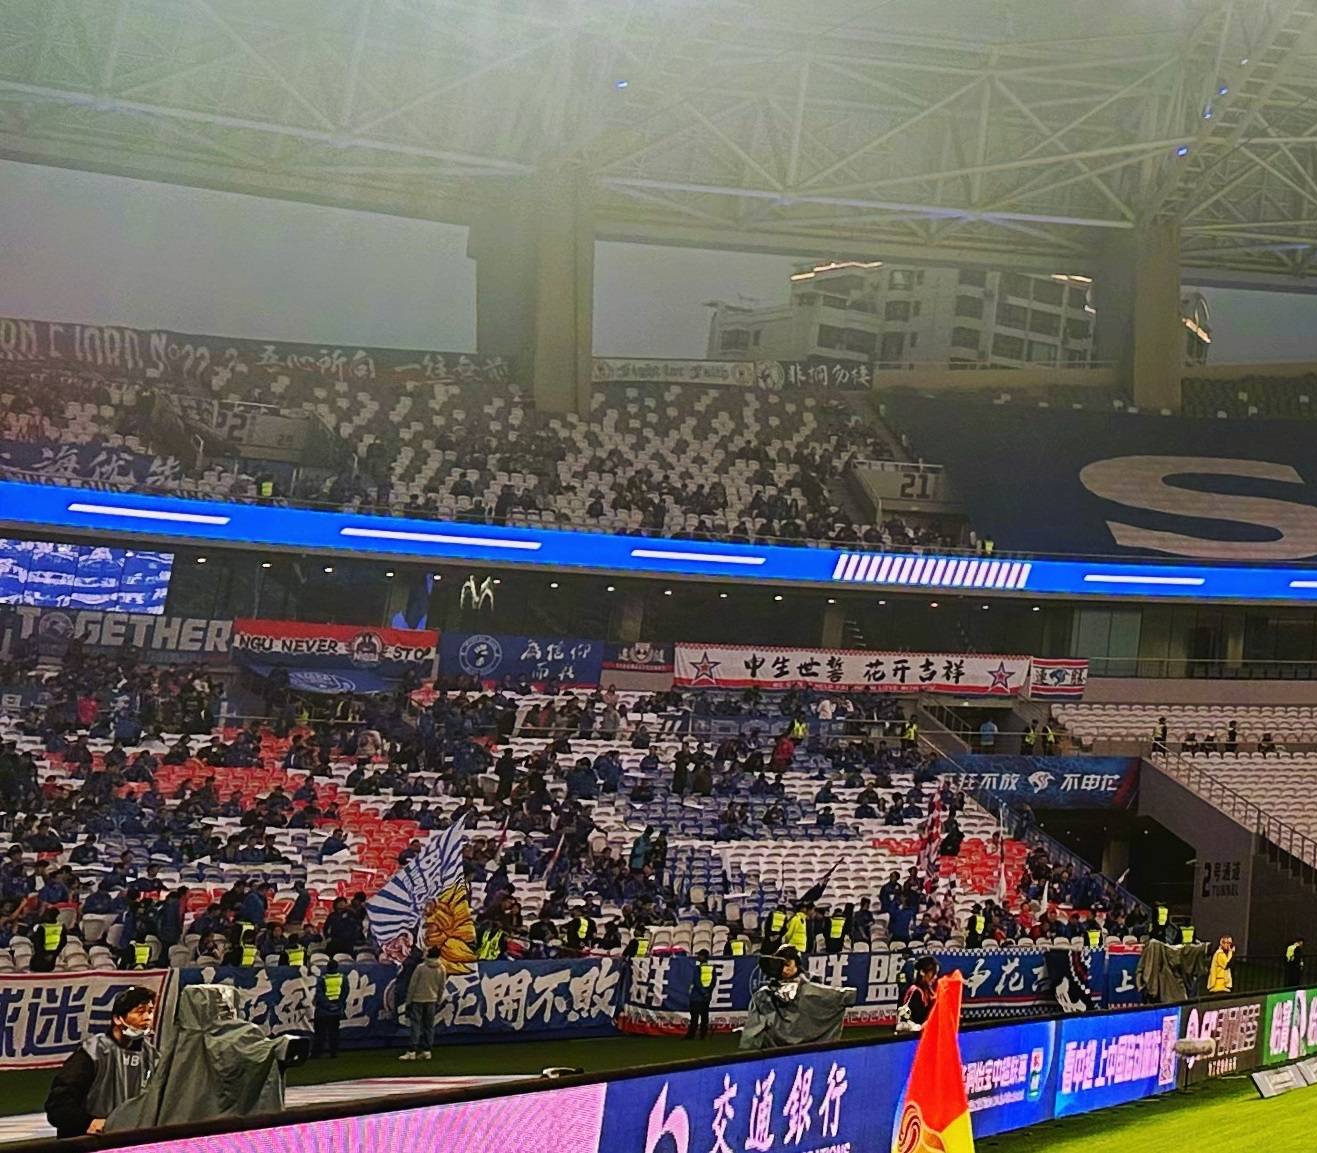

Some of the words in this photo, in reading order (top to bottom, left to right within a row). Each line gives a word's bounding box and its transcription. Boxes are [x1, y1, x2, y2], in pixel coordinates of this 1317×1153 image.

[900, 470, 936, 500] 21
[281, 639, 339, 654] NEVER
[864, 658, 966, 684] 花开吉祥
[709, 1061, 848, 1153] 交通銀行
